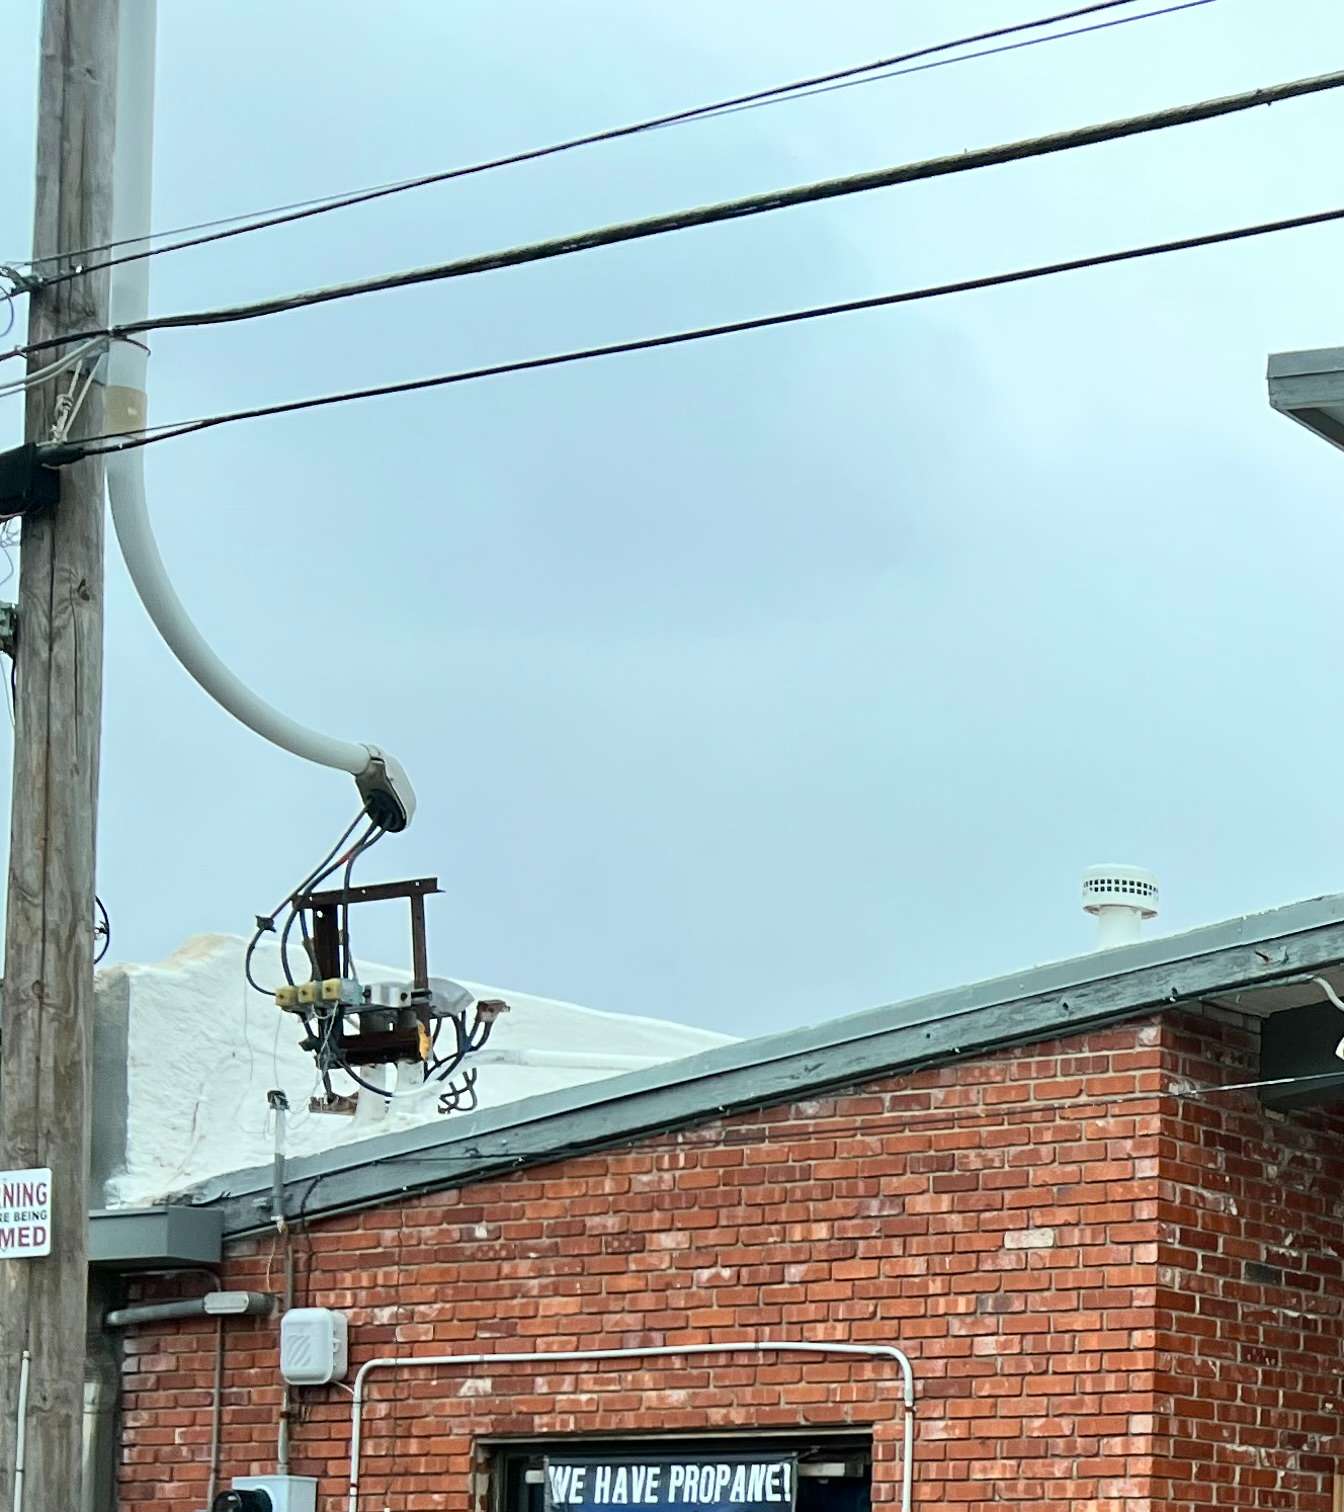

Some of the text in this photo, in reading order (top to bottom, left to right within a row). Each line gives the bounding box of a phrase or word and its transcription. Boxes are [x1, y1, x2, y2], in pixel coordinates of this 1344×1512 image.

[0, 1182, 47, 1208] NING
[14, 1210, 47, 1222] BEING
[549, 1463, 792, 1504] WE HAVE PROPANE!
